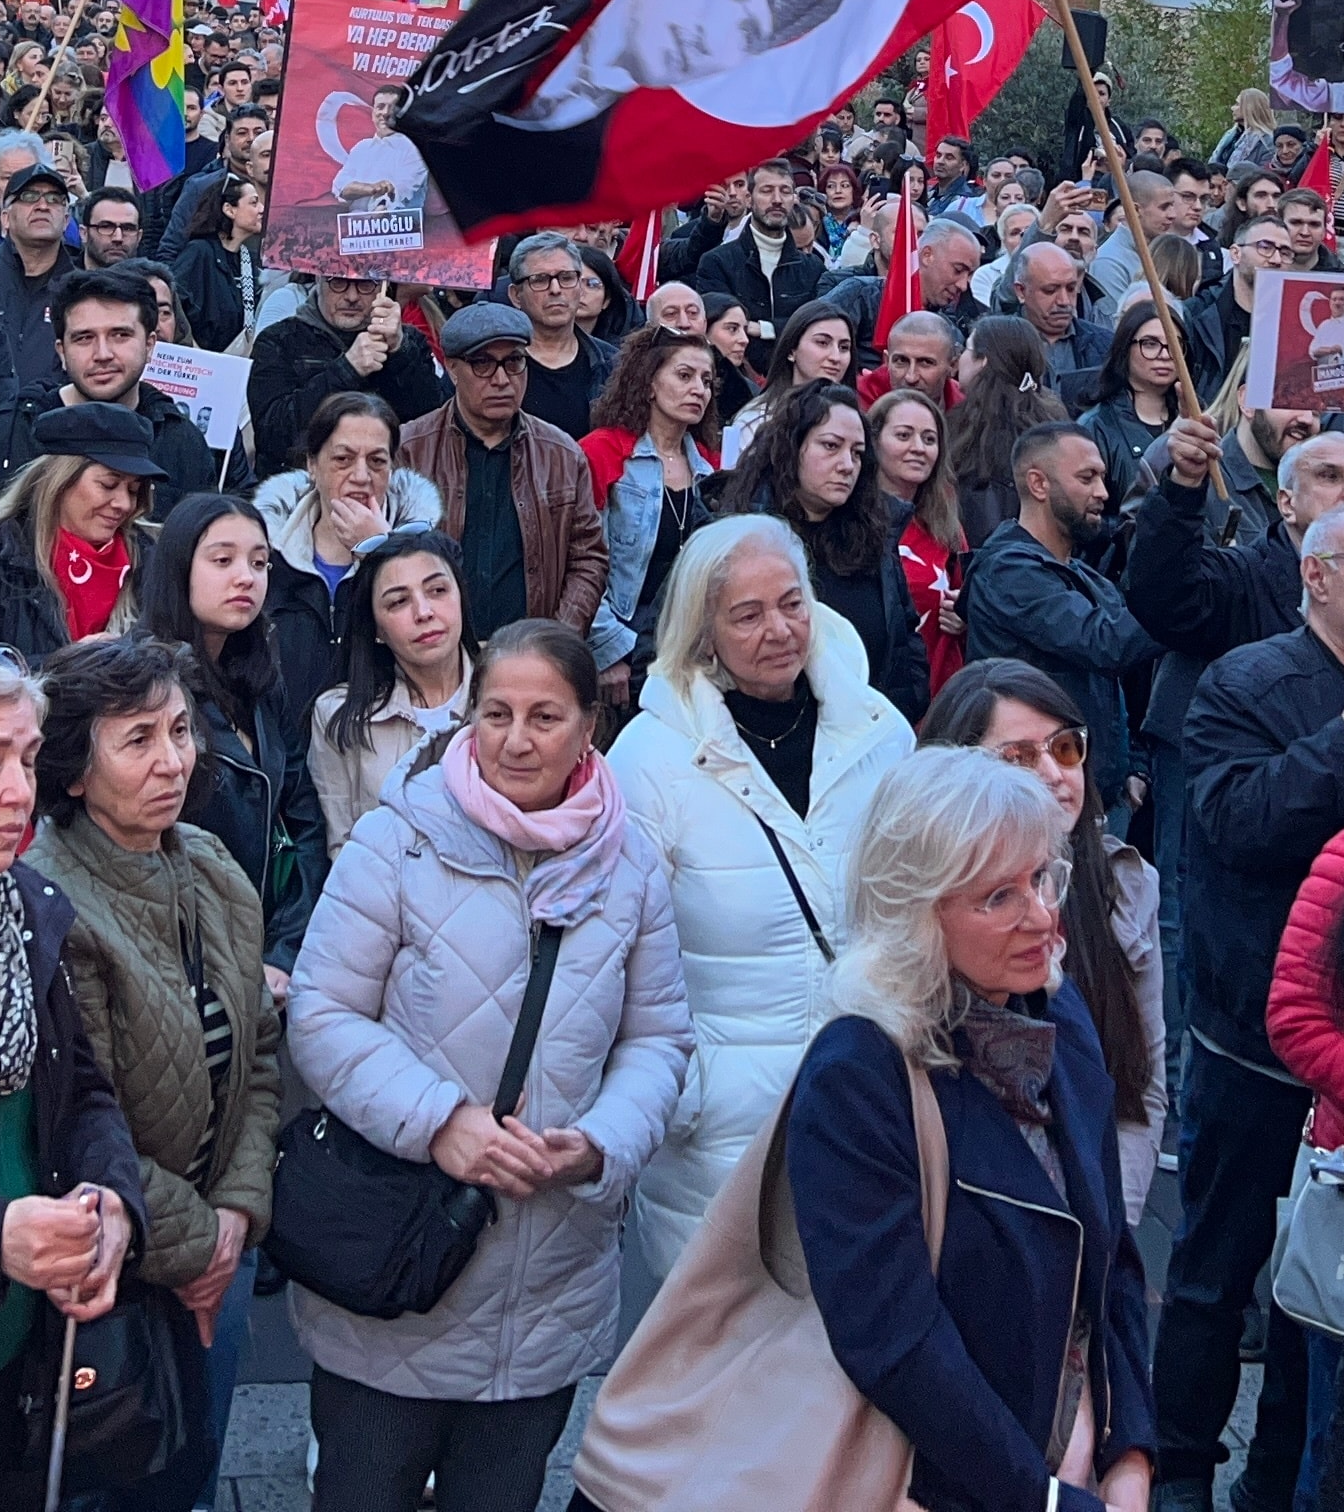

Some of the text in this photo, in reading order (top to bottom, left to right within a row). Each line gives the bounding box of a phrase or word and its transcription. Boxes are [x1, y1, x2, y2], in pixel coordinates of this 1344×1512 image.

[396, 12, 414, 26] YOK
[417, 15, 433, 28] TEK
[347, 24, 365, 44] YA
[366, 27, 397, 48] HEP
[352, 51, 371, 72] YA
[346, 214, 414, 237] İMAMOĞLU
[156, 353, 175, 362] NEIN
